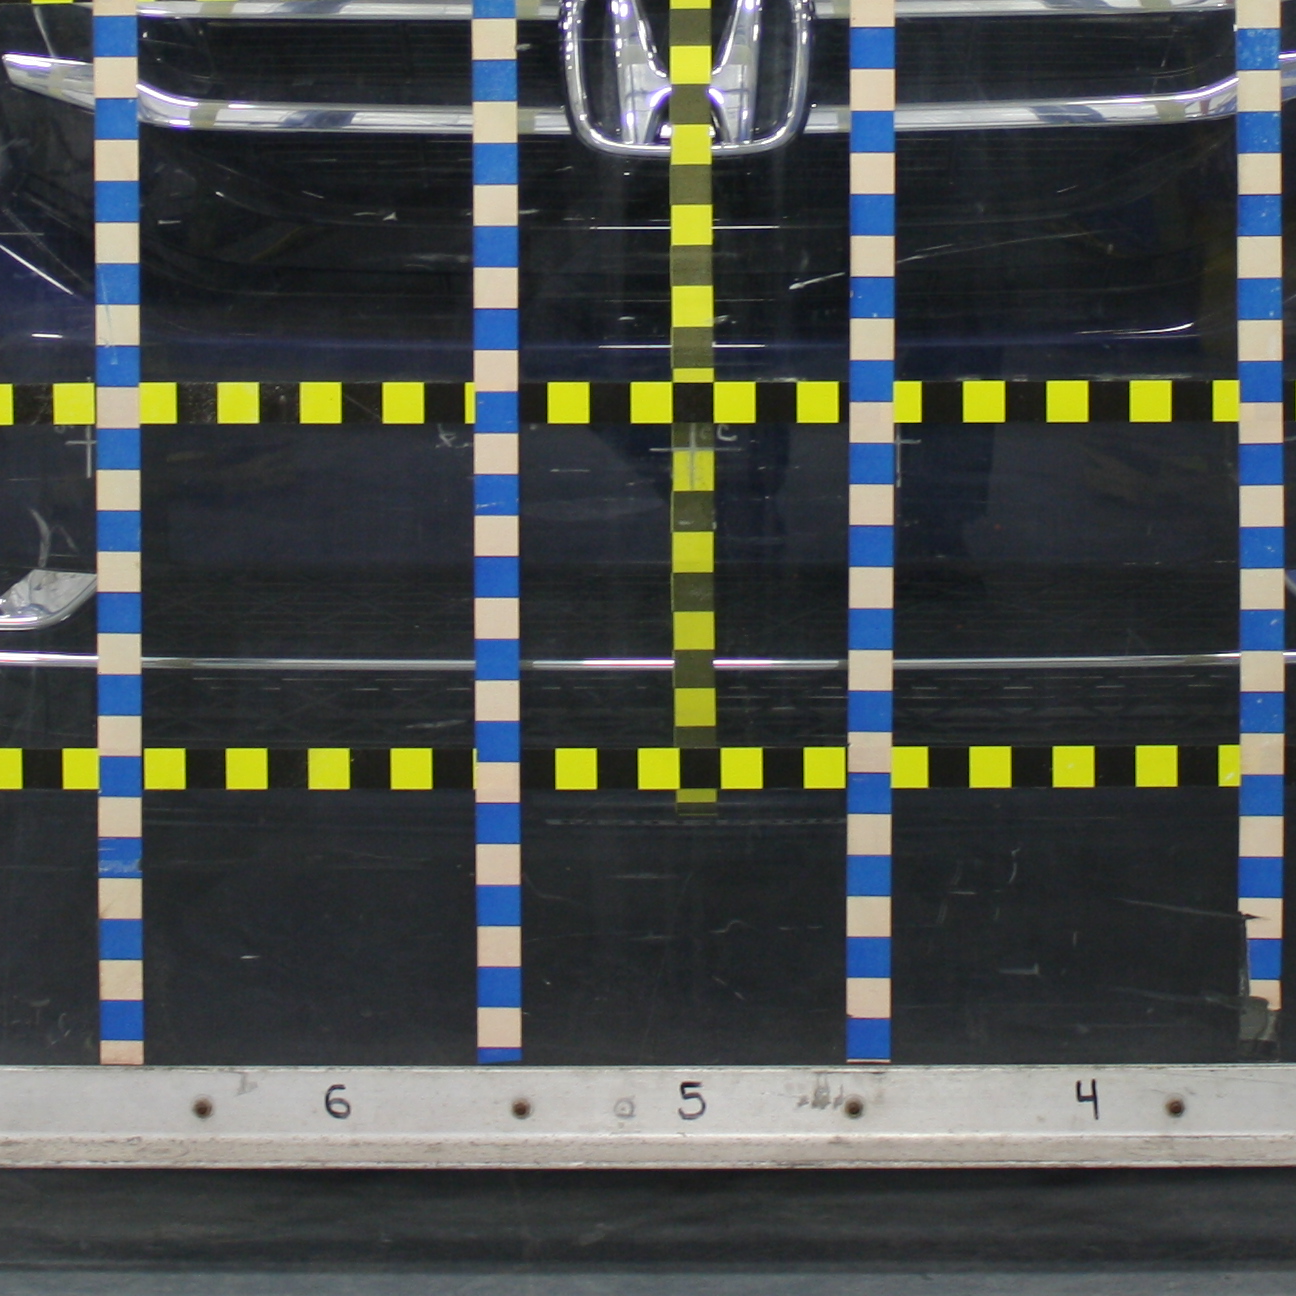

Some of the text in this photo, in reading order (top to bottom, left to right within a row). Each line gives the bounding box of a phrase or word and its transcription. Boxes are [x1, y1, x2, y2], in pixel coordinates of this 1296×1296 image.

[324, 1084, 352, 1119] 6
[678, 1081, 706, 1121] 5
[1076, 1078, 1100, 1121] 4
